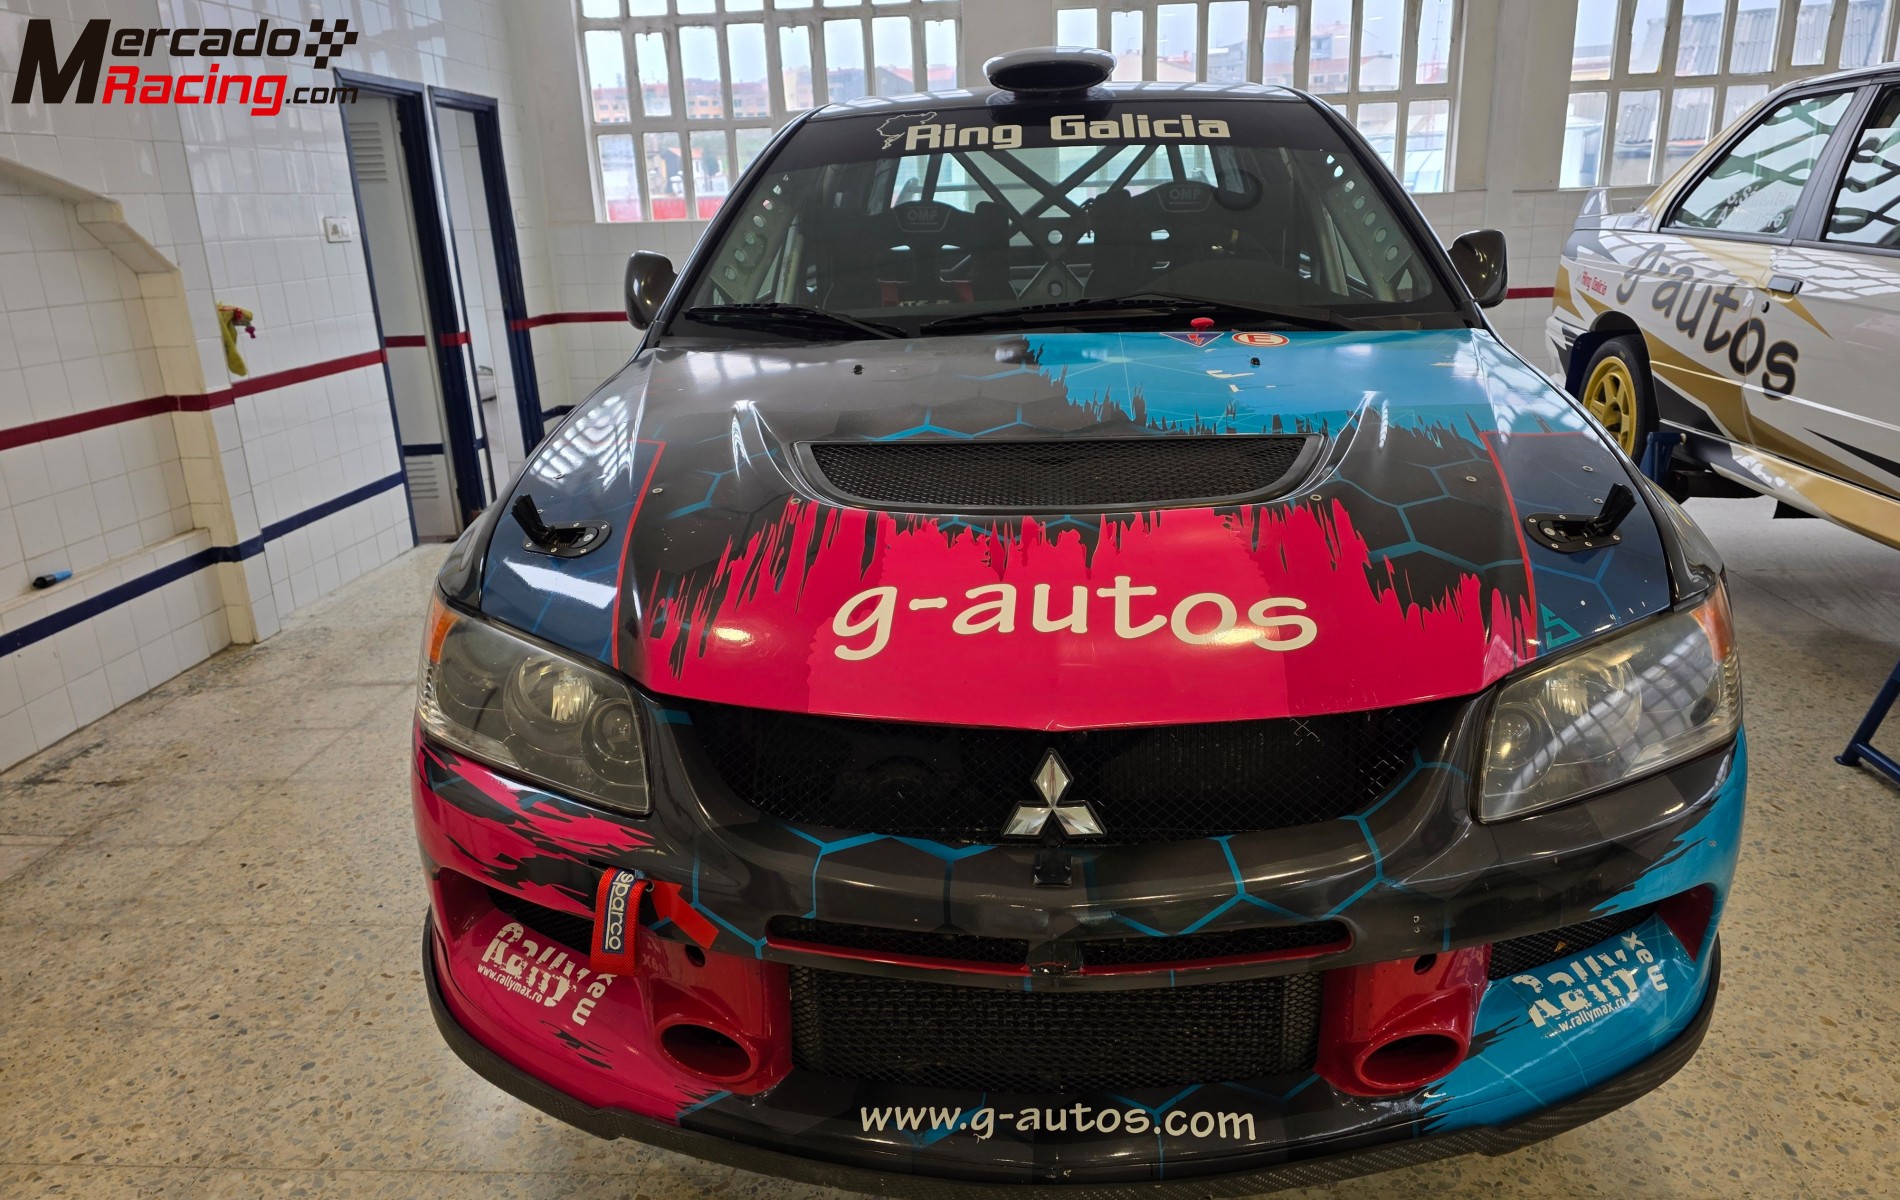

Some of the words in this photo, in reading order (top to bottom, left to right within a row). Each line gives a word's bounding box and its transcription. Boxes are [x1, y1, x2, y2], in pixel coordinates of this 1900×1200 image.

[905, 122, 1022, 150] Ring
[1050, 113, 1230, 140] Galicia
[1169, 188, 1201, 201] OMP
[907, 209, 938, 221] OMP
[832, 575, 1318, 661] g-autos
[604, 869, 634, 951] sparco
[477, 962, 543, 1004] www.rallymax.ro
[1544, 997, 1627, 1039] w.rallymax.ro
[860, 1102, 1257, 1141] www.g-autos.com
